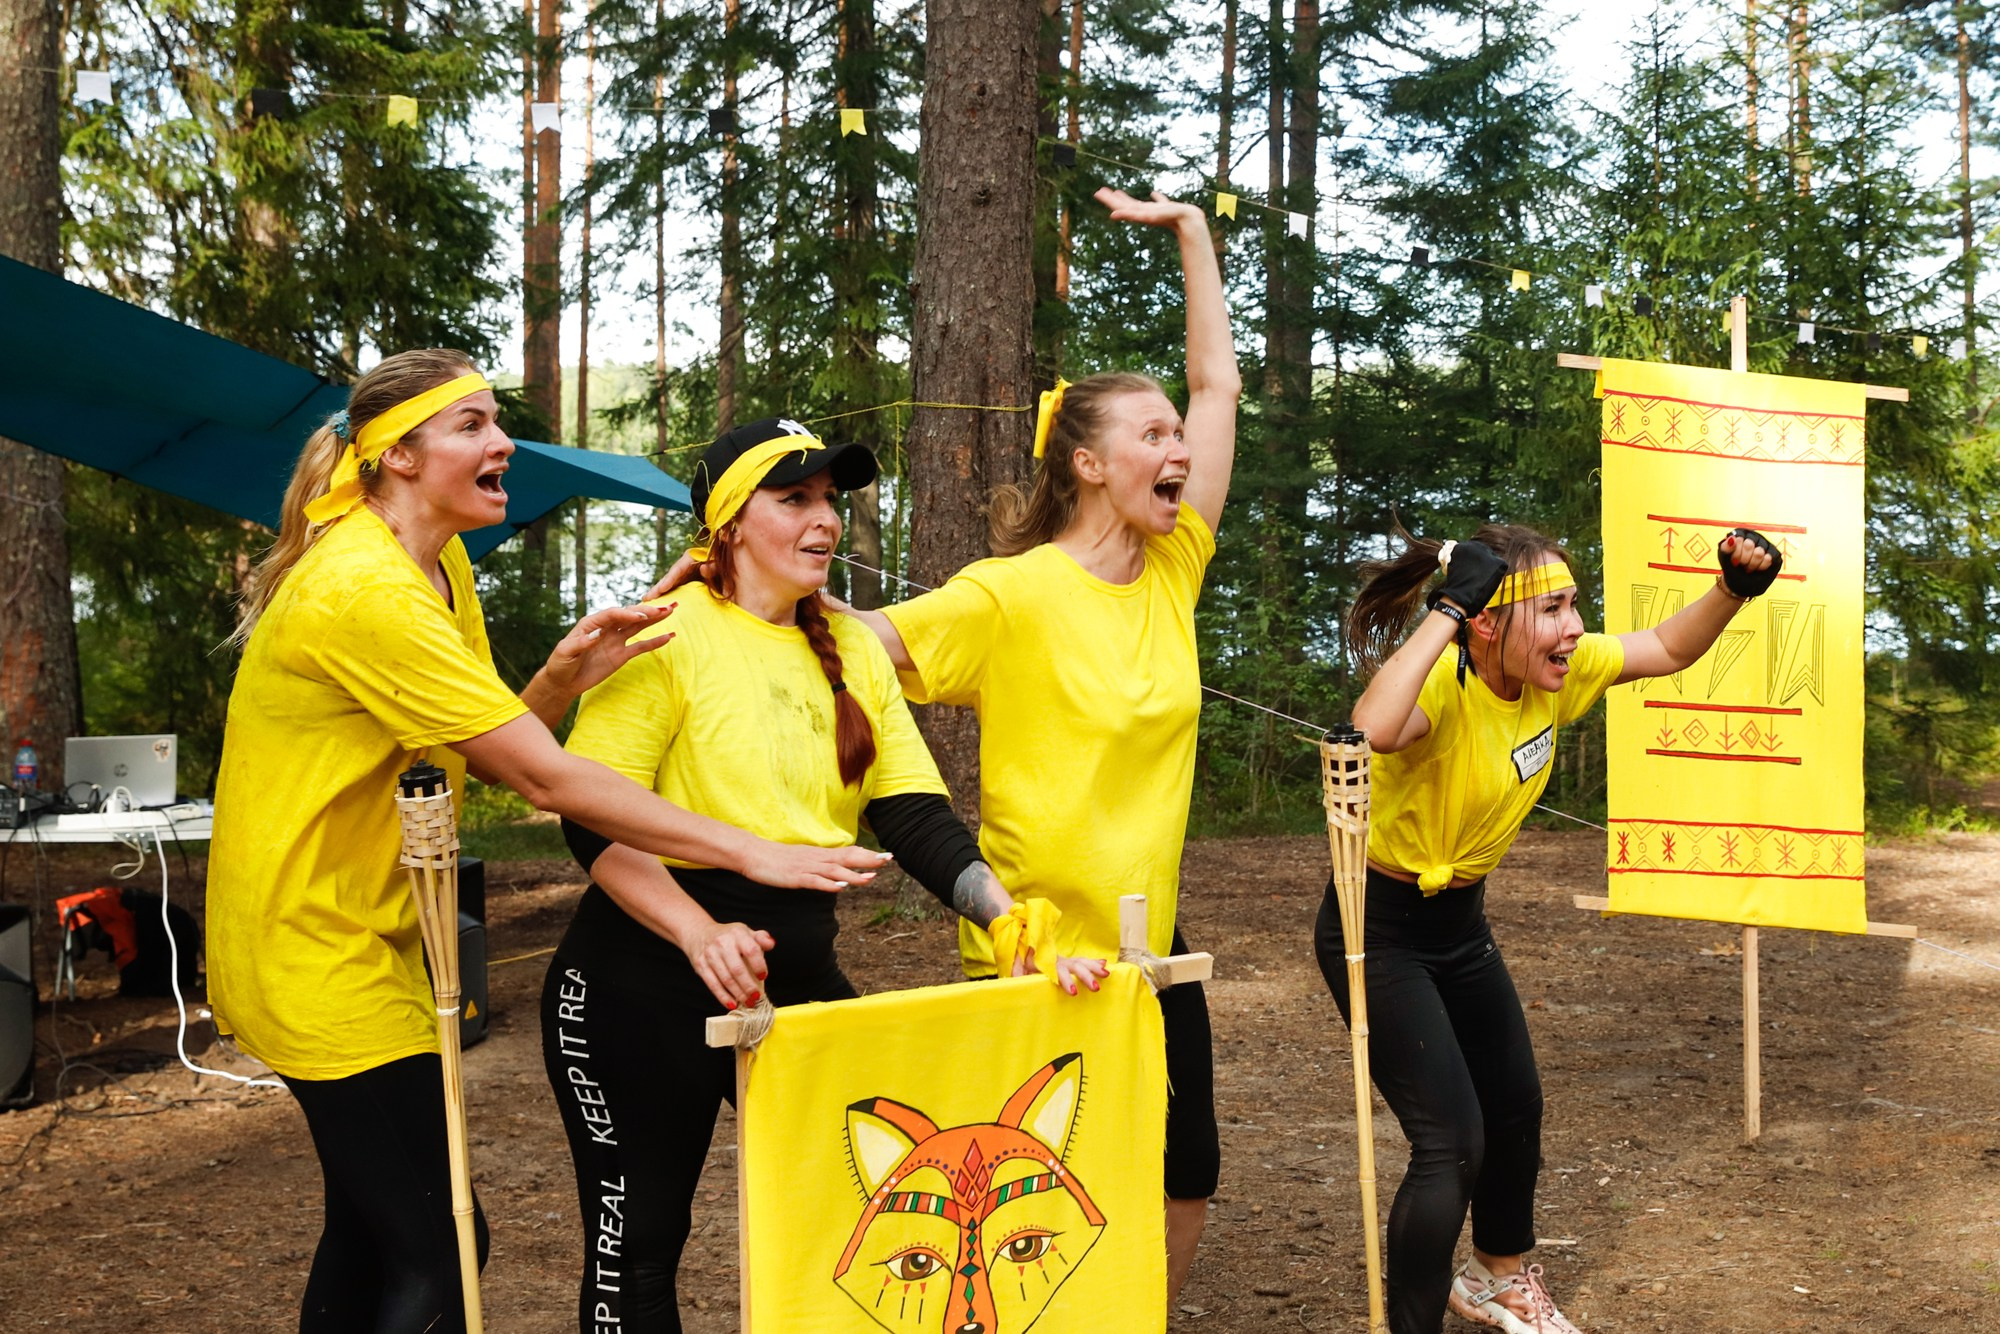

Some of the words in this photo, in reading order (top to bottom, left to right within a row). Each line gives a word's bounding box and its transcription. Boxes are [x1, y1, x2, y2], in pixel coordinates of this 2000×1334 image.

[558, 1027, 590, 1058] IT
[567, 1066, 618, 1146] KEEP
[597, 1175, 625, 1257] REAL
[596, 1260, 621, 1293] IT
